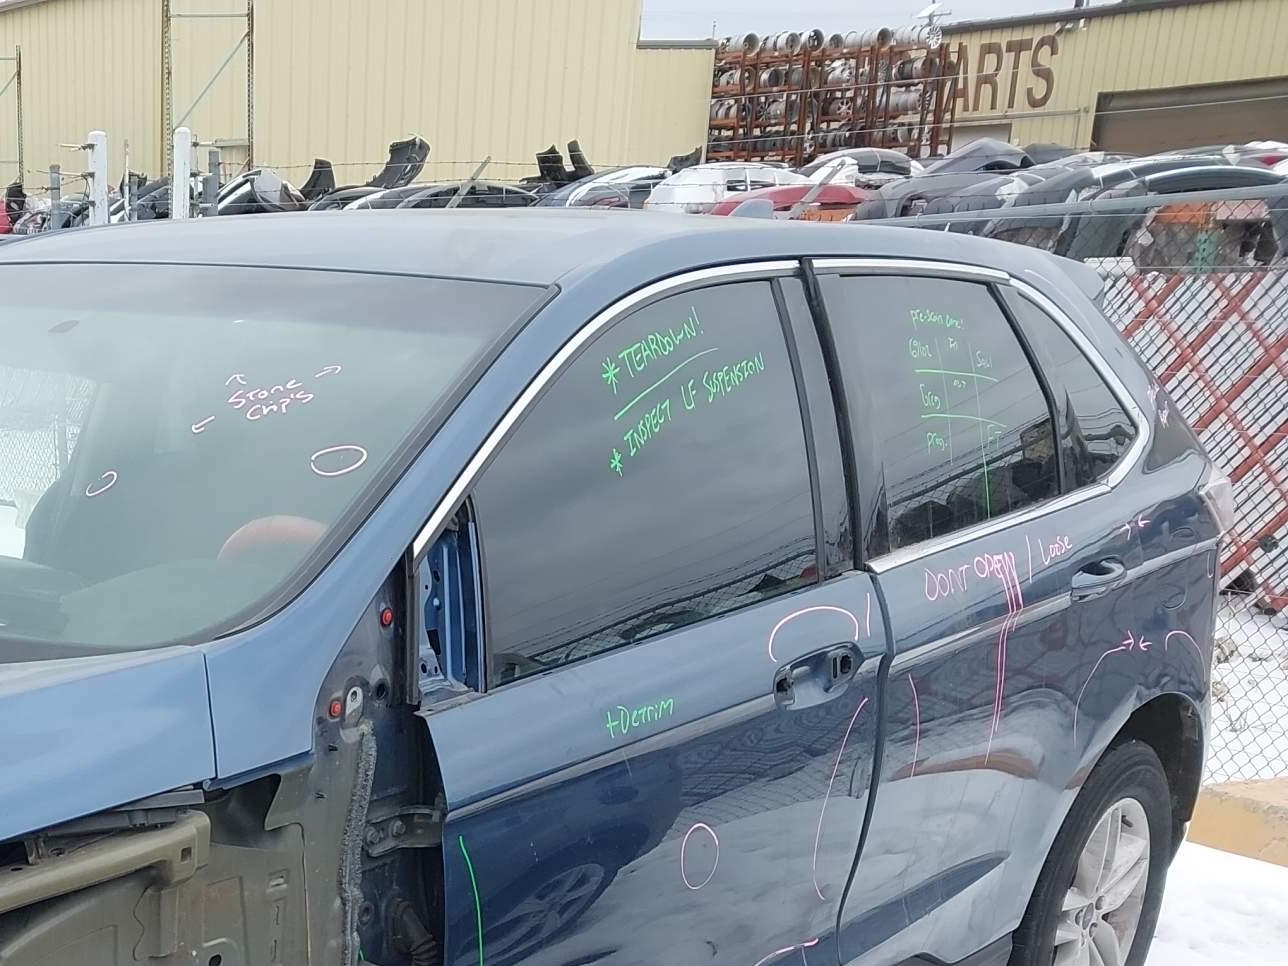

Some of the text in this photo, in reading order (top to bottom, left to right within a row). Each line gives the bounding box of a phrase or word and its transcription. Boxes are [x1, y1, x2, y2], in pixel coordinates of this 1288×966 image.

[938, 35, 1059, 112] ARTS
[623, 400, 672, 457] INSPECT
[703, 352, 765, 403] SUSPENSION
